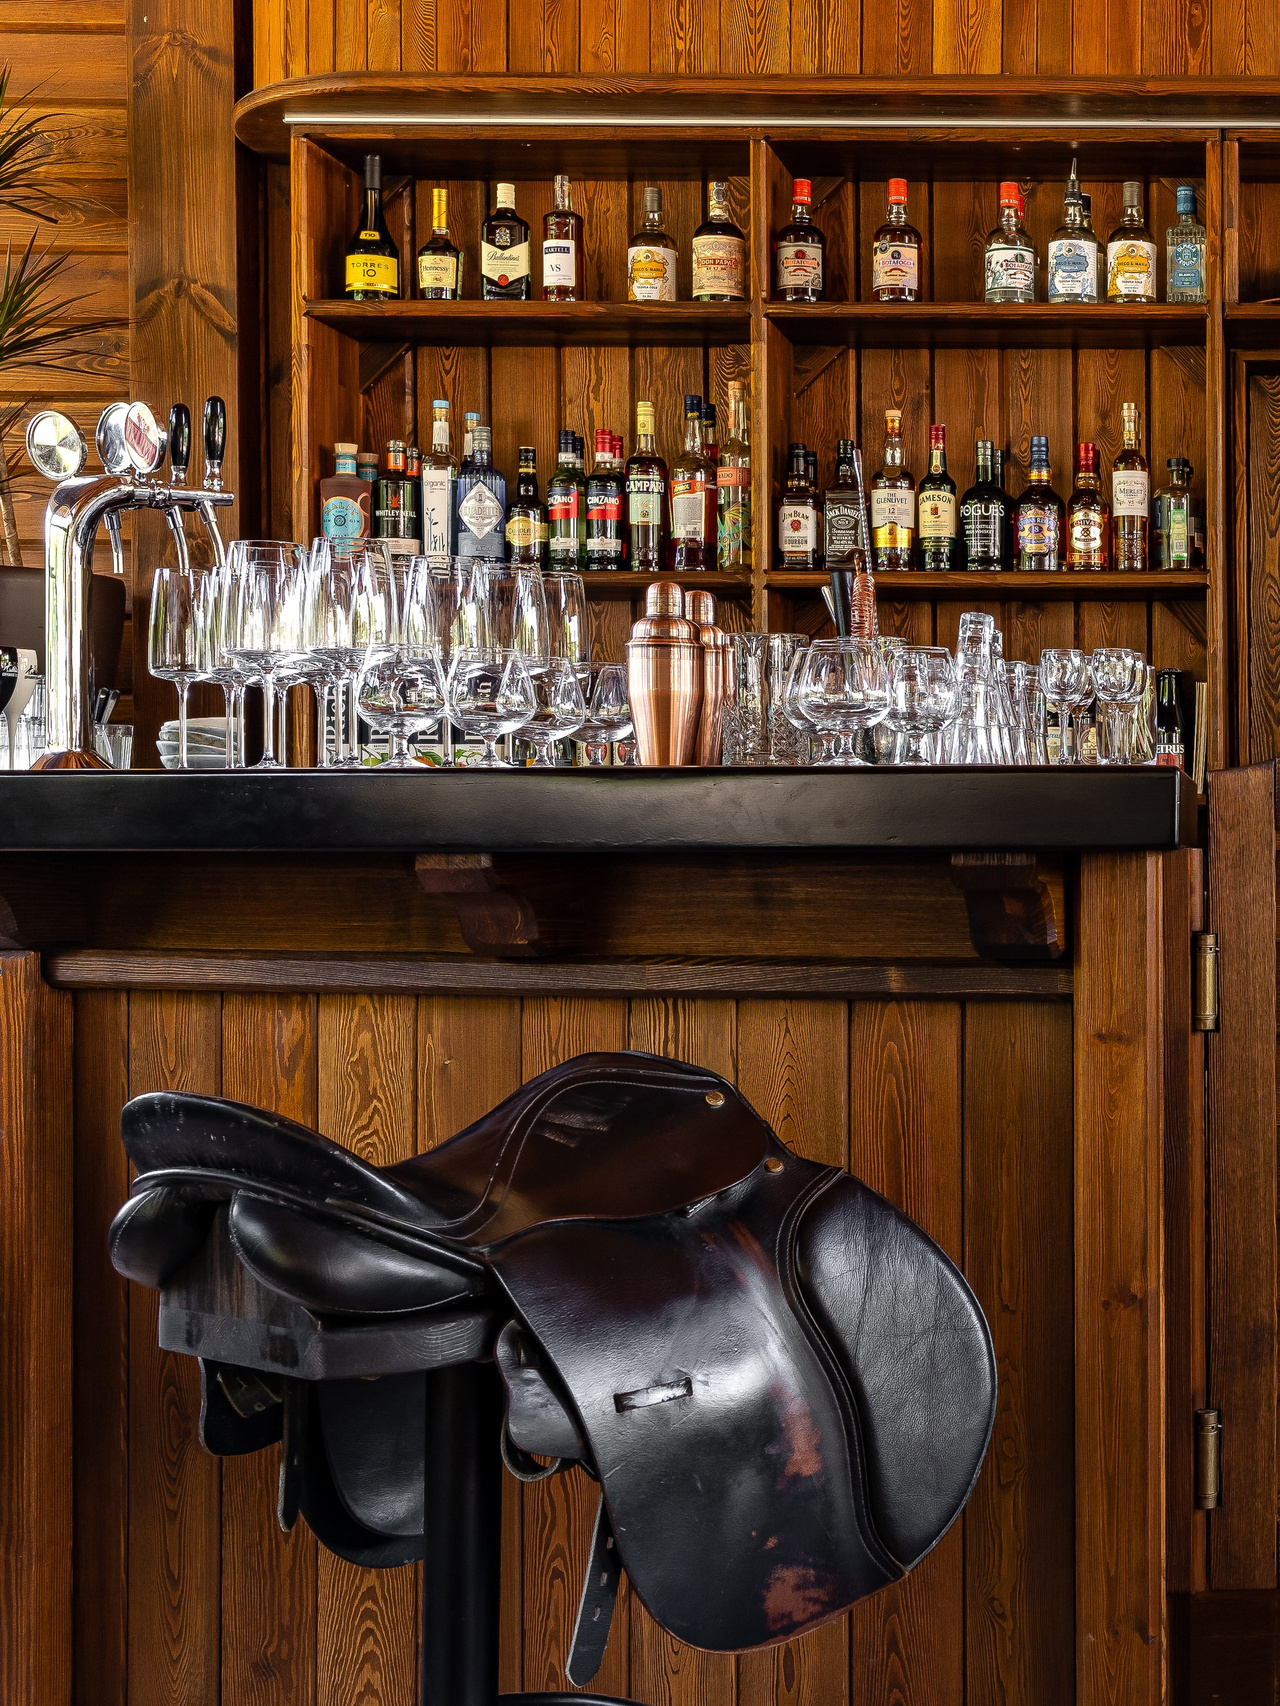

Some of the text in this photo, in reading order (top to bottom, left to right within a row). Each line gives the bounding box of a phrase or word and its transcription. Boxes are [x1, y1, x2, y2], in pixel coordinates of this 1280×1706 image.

[486, 250, 520, 261] Ballantine's
[351, 262, 389, 270] TORRES
[422, 264, 449, 273] Hennessy
[550, 264, 561, 272] VS
[362, 268, 376, 278] 10
[626, 480, 664, 492] CAMPARI
[548, 495, 574, 504] INZANO
[587, 495, 620, 504] CINZANO
[919, 494, 952, 506] JAMESON
[782, 510, 809, 522] JIM BEAM
[826, 508, 840, 520] JACK
[960, 504, 1005, 517] POGUES
[1156, 744, 1185, 755] ETRUS
